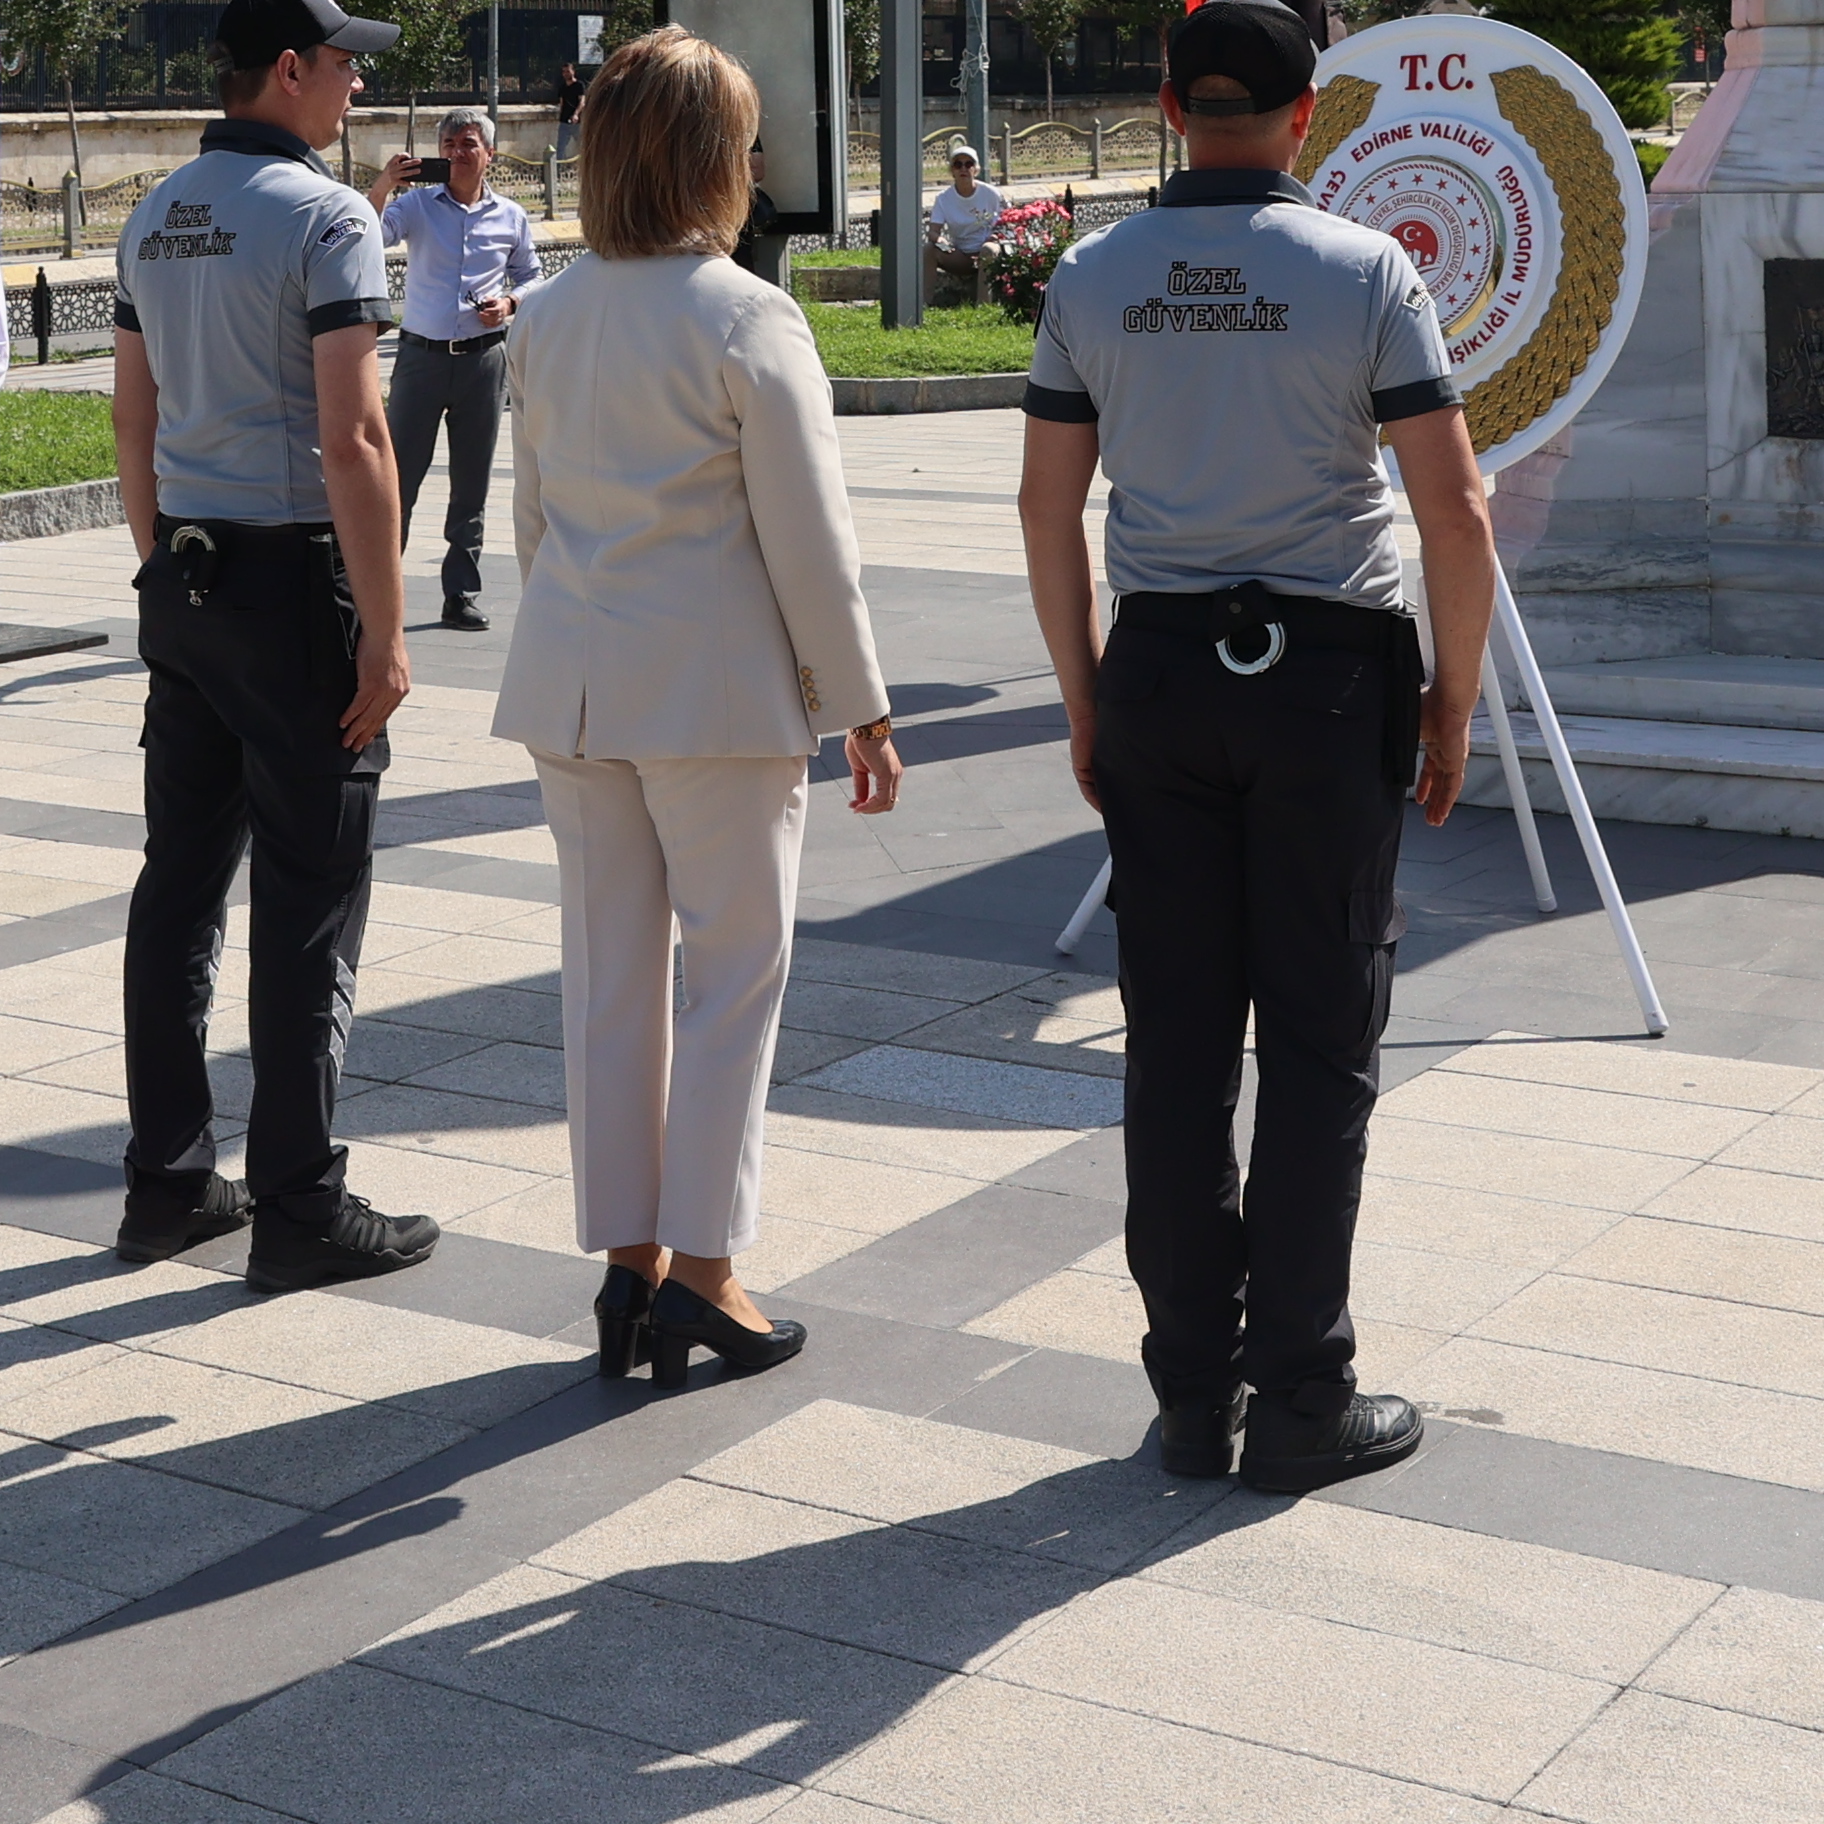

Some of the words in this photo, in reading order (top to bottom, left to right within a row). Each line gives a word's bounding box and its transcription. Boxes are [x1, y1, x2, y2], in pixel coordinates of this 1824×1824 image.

[1399, 53, 1474, 91] T.C.
[1350, 124, 1414, 163] EDİRNE
[1420, 122, 1495, 157] VALİLİĞİ
[165, 200, 212, 228] ÖZEL
[1495, 165, 1532, 283] MÜDÜRLÜĞÜ
[138, 227, 236, 260] GÜVENLİK
[1392, 192, 1432, 208] ŞEHİRCİLİK
[1431, 198, 1441, 210] VE
[1439, 204, 1456, 226] İKLİM
[1450, 224, 1464, 275] DEĞİŞİKLİĞİ
[1167, 261, 1247, 295] ÖZEL
[1123, 296, 1289, 333] GÜVENLİK
[1500, 289, 1522, 306] İL
